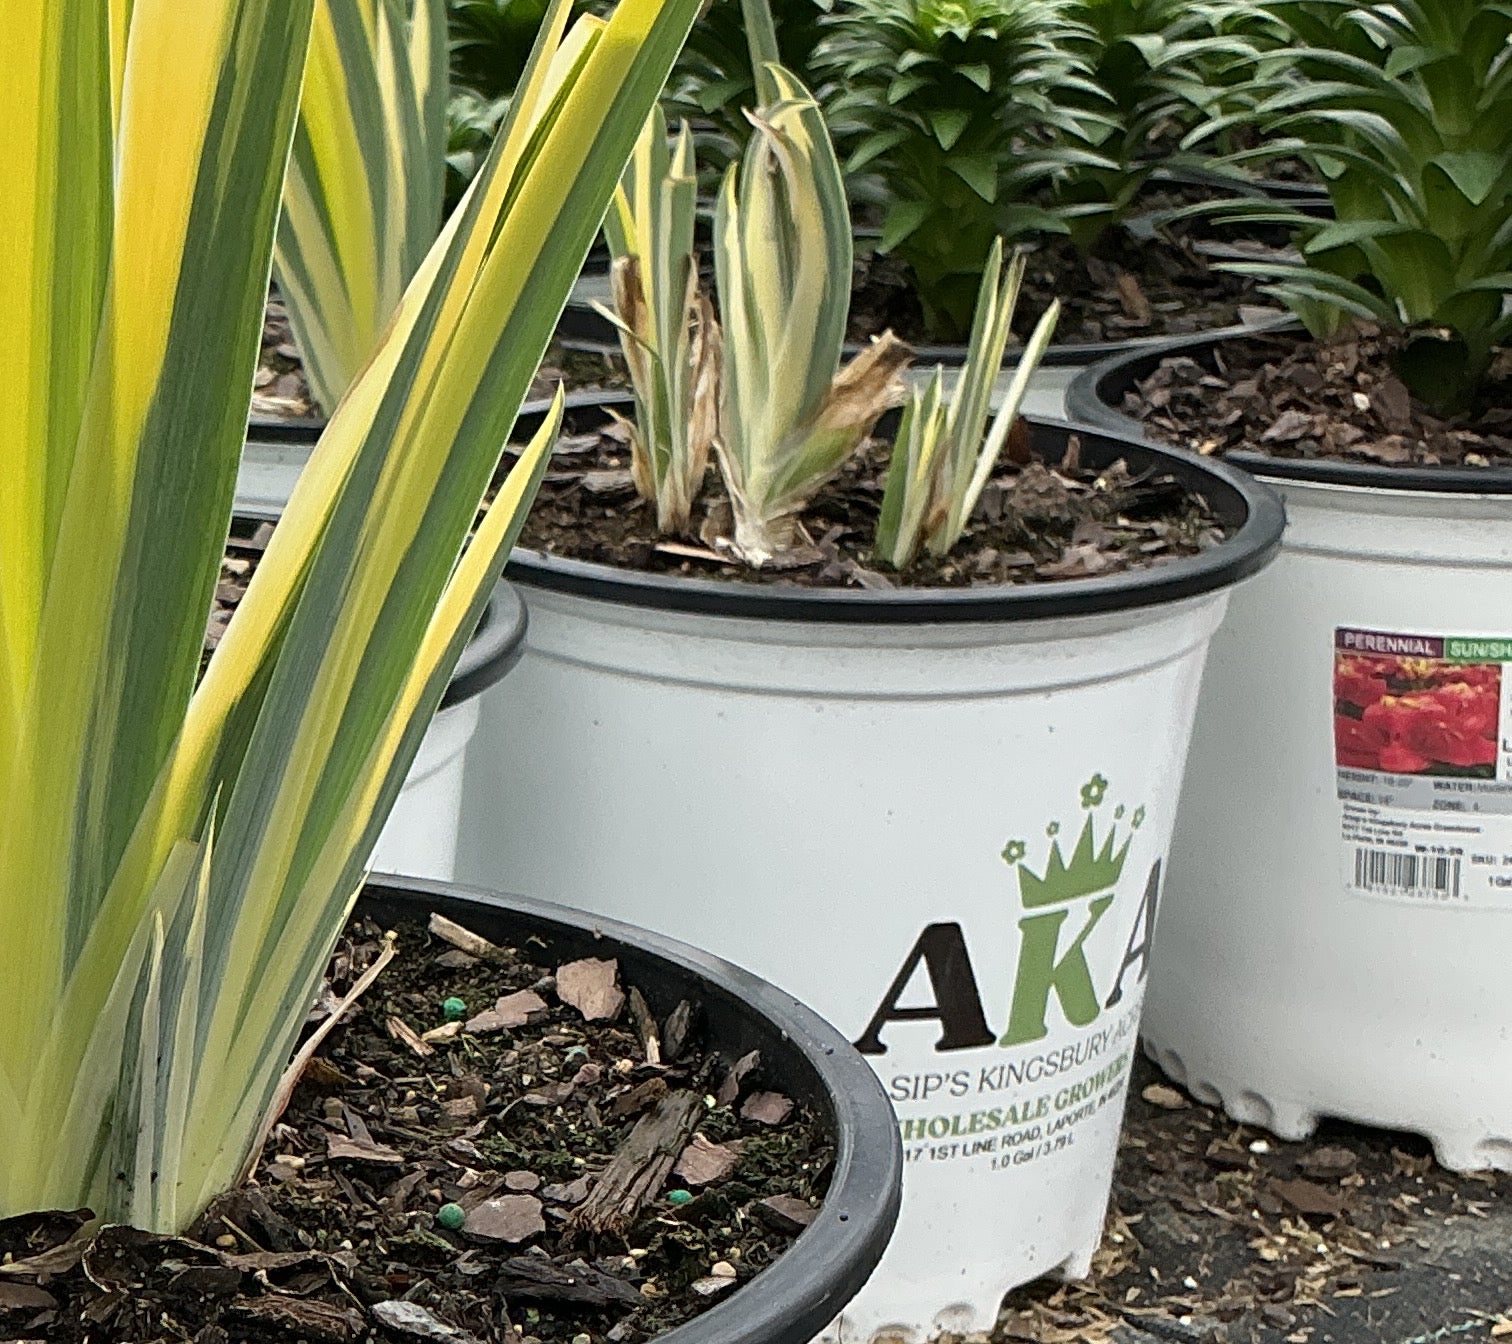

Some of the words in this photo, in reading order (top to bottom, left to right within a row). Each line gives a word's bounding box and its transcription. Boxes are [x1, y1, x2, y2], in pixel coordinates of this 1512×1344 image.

[1343, 632, 1435, 656] PERENNIAL
[855, 856, 1162, 1055] AKA
[890, 1069, 970, 1102] SIP'S
[977, 1023, 1113, 1093] KINGSBURY
[900, 1094, 1051, 1141] HOLESALE
[905, 1147, 923, 1162] 17
